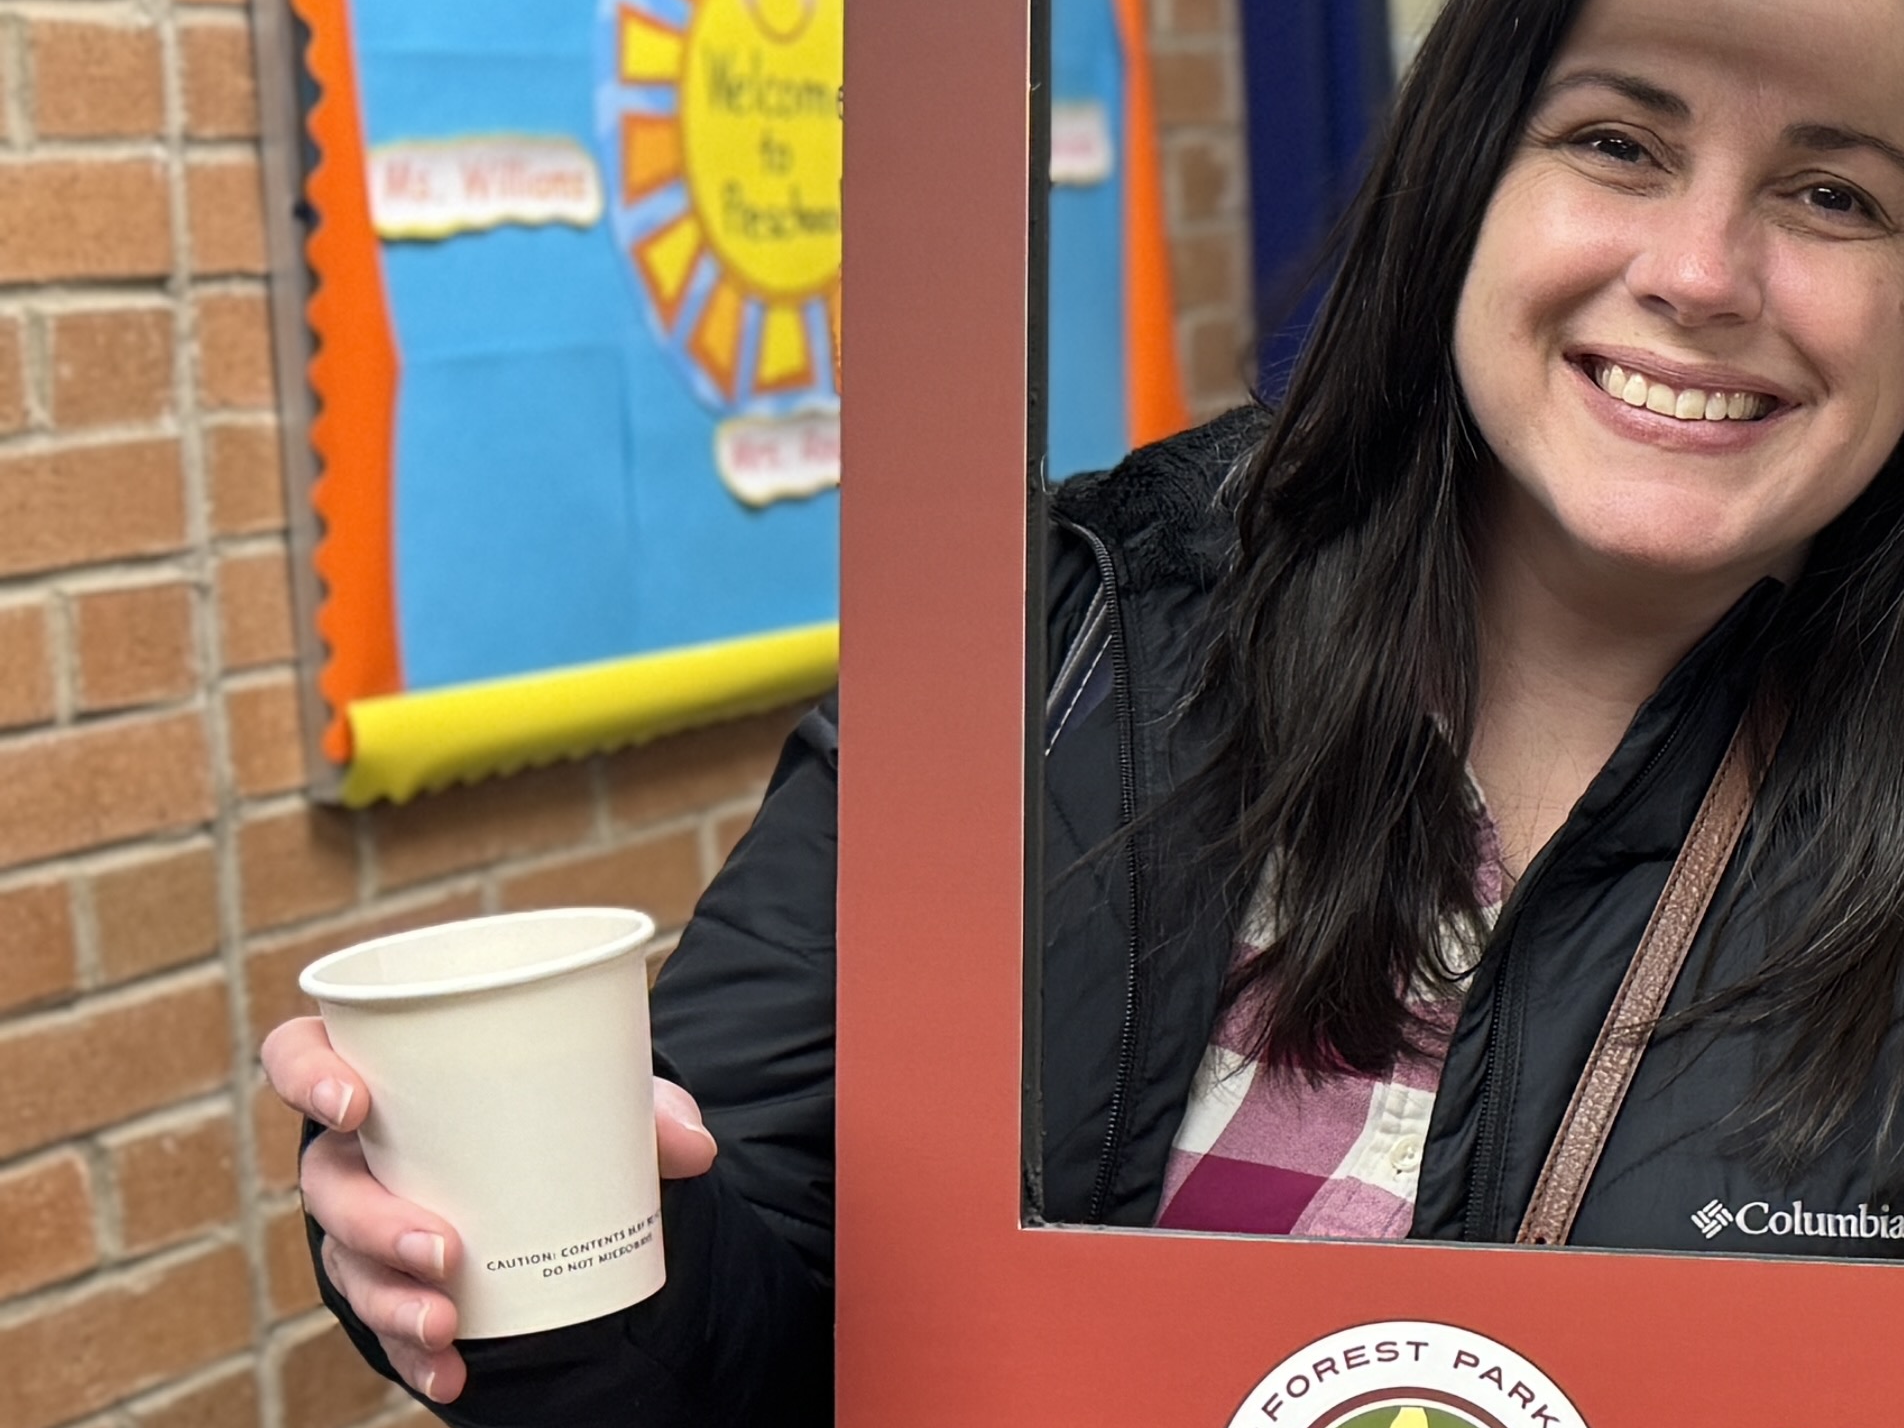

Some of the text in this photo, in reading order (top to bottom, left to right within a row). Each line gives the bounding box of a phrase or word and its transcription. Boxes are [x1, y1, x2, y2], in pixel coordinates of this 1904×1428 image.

[542, 1264, 564, 1278] DO
[567, 1257, 594, 1272] NOT
[1261, 1340, 1429, 1422] FOREST
